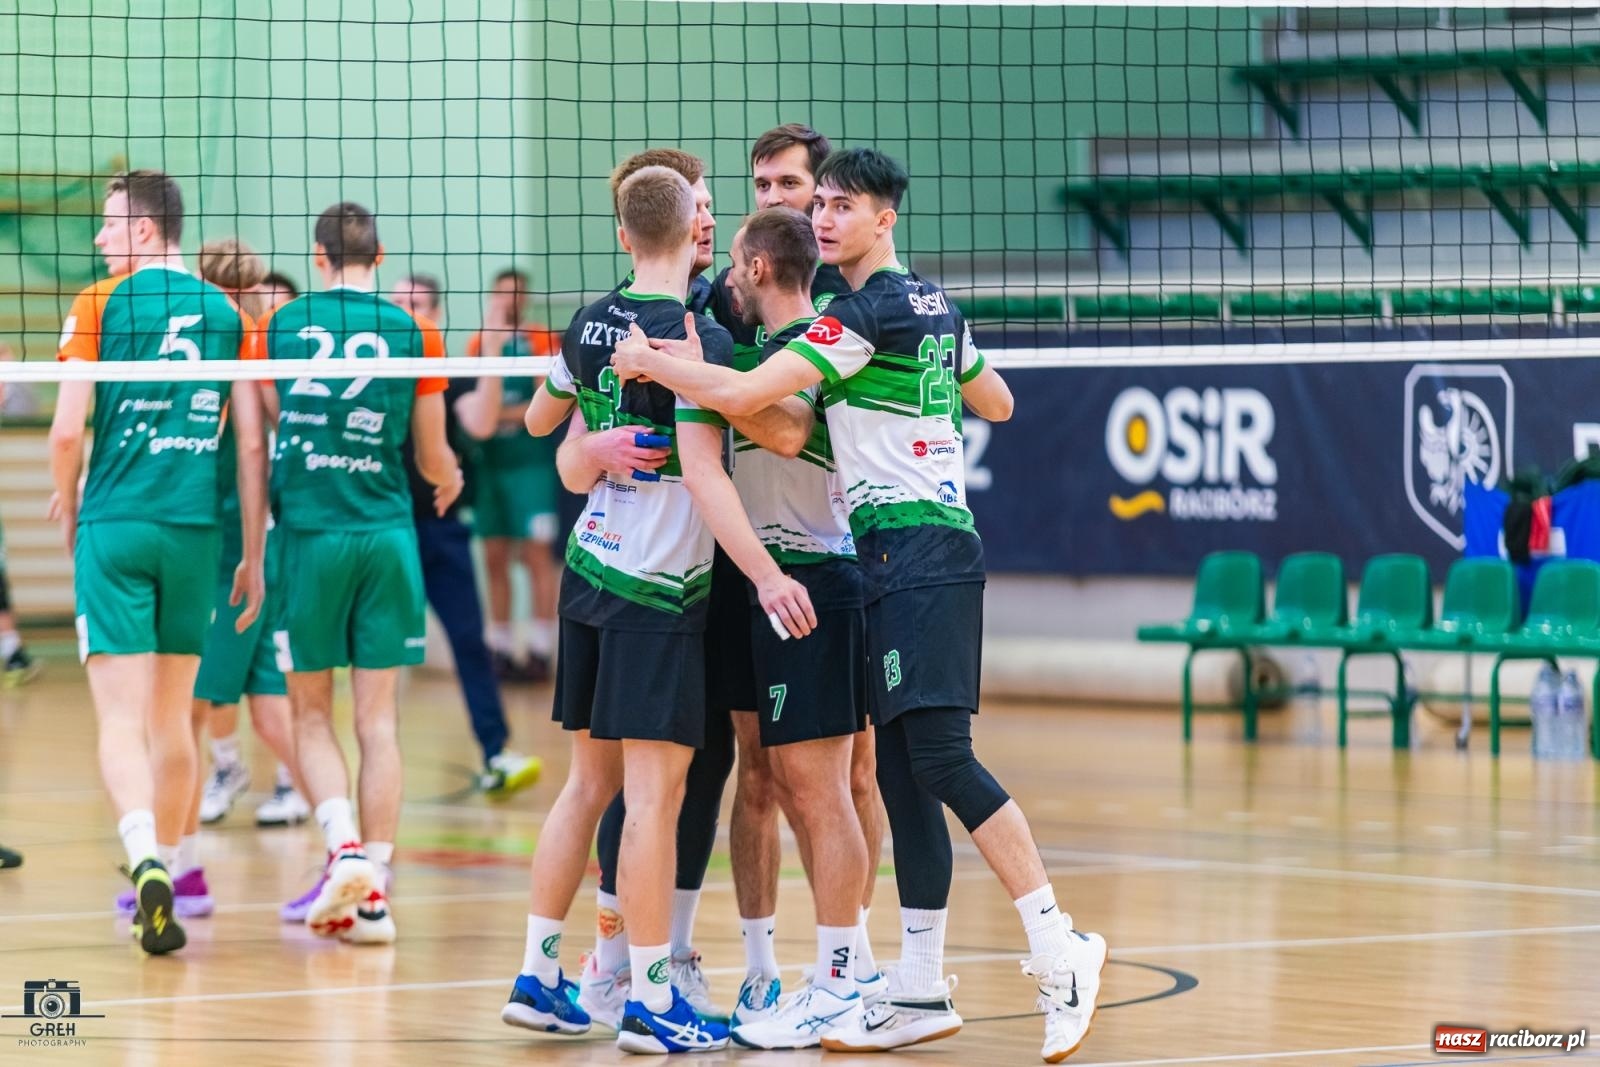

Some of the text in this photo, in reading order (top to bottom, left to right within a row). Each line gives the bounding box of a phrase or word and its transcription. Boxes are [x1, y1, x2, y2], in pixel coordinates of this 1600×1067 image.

[157, 314, 203, 361] 5
[289, 325, 389, 399] 29
[919, 334, 956, 417] 23
[1105, 386, 1278, 486] OSiR
[884, 650, 902, 691] 23
[769, 684, 787, 722] 7
[831, 946, 849, 979] FILA
